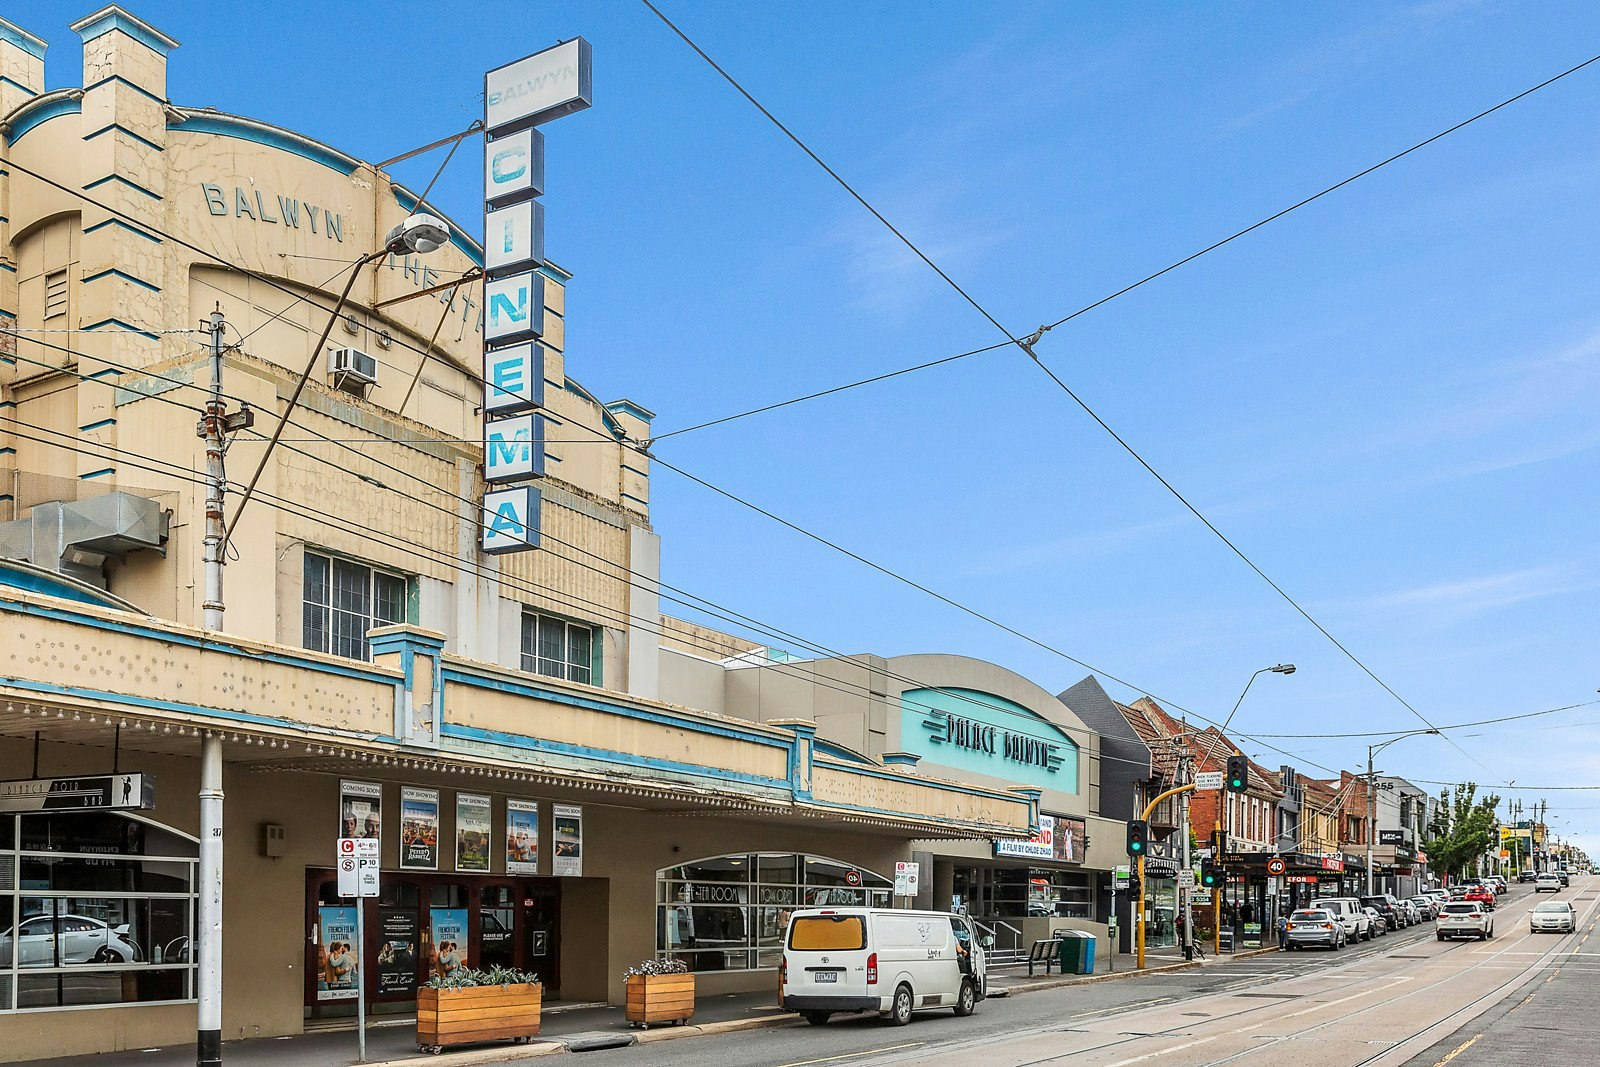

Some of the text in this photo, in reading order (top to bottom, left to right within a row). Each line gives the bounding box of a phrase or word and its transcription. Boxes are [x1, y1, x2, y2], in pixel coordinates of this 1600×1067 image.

[488, 64, 577, 107] BALWYN
[201, 182, 343, 243] BALWYN
[486, 143, 530, 538] CINEMA
[946, 714, 1048, 768] PALACE BALWYN
[1374, 782, 1394, 790] 255
[84, 796, 103, 806] BAR
[213, 828, 221, 837] 37
[1007, 844, 1017, 852] FILM
[1025, 845, 1039, 854] CHLOE
[425, 849, 430, 861] 2
[360, 860, 367, 868] P
[1270, 862, 1282, 871] 40
[678, 886, 694, 900] CE
[711, 887, 738, 901] ROOM
[344, 925, 354, 933] FILM
